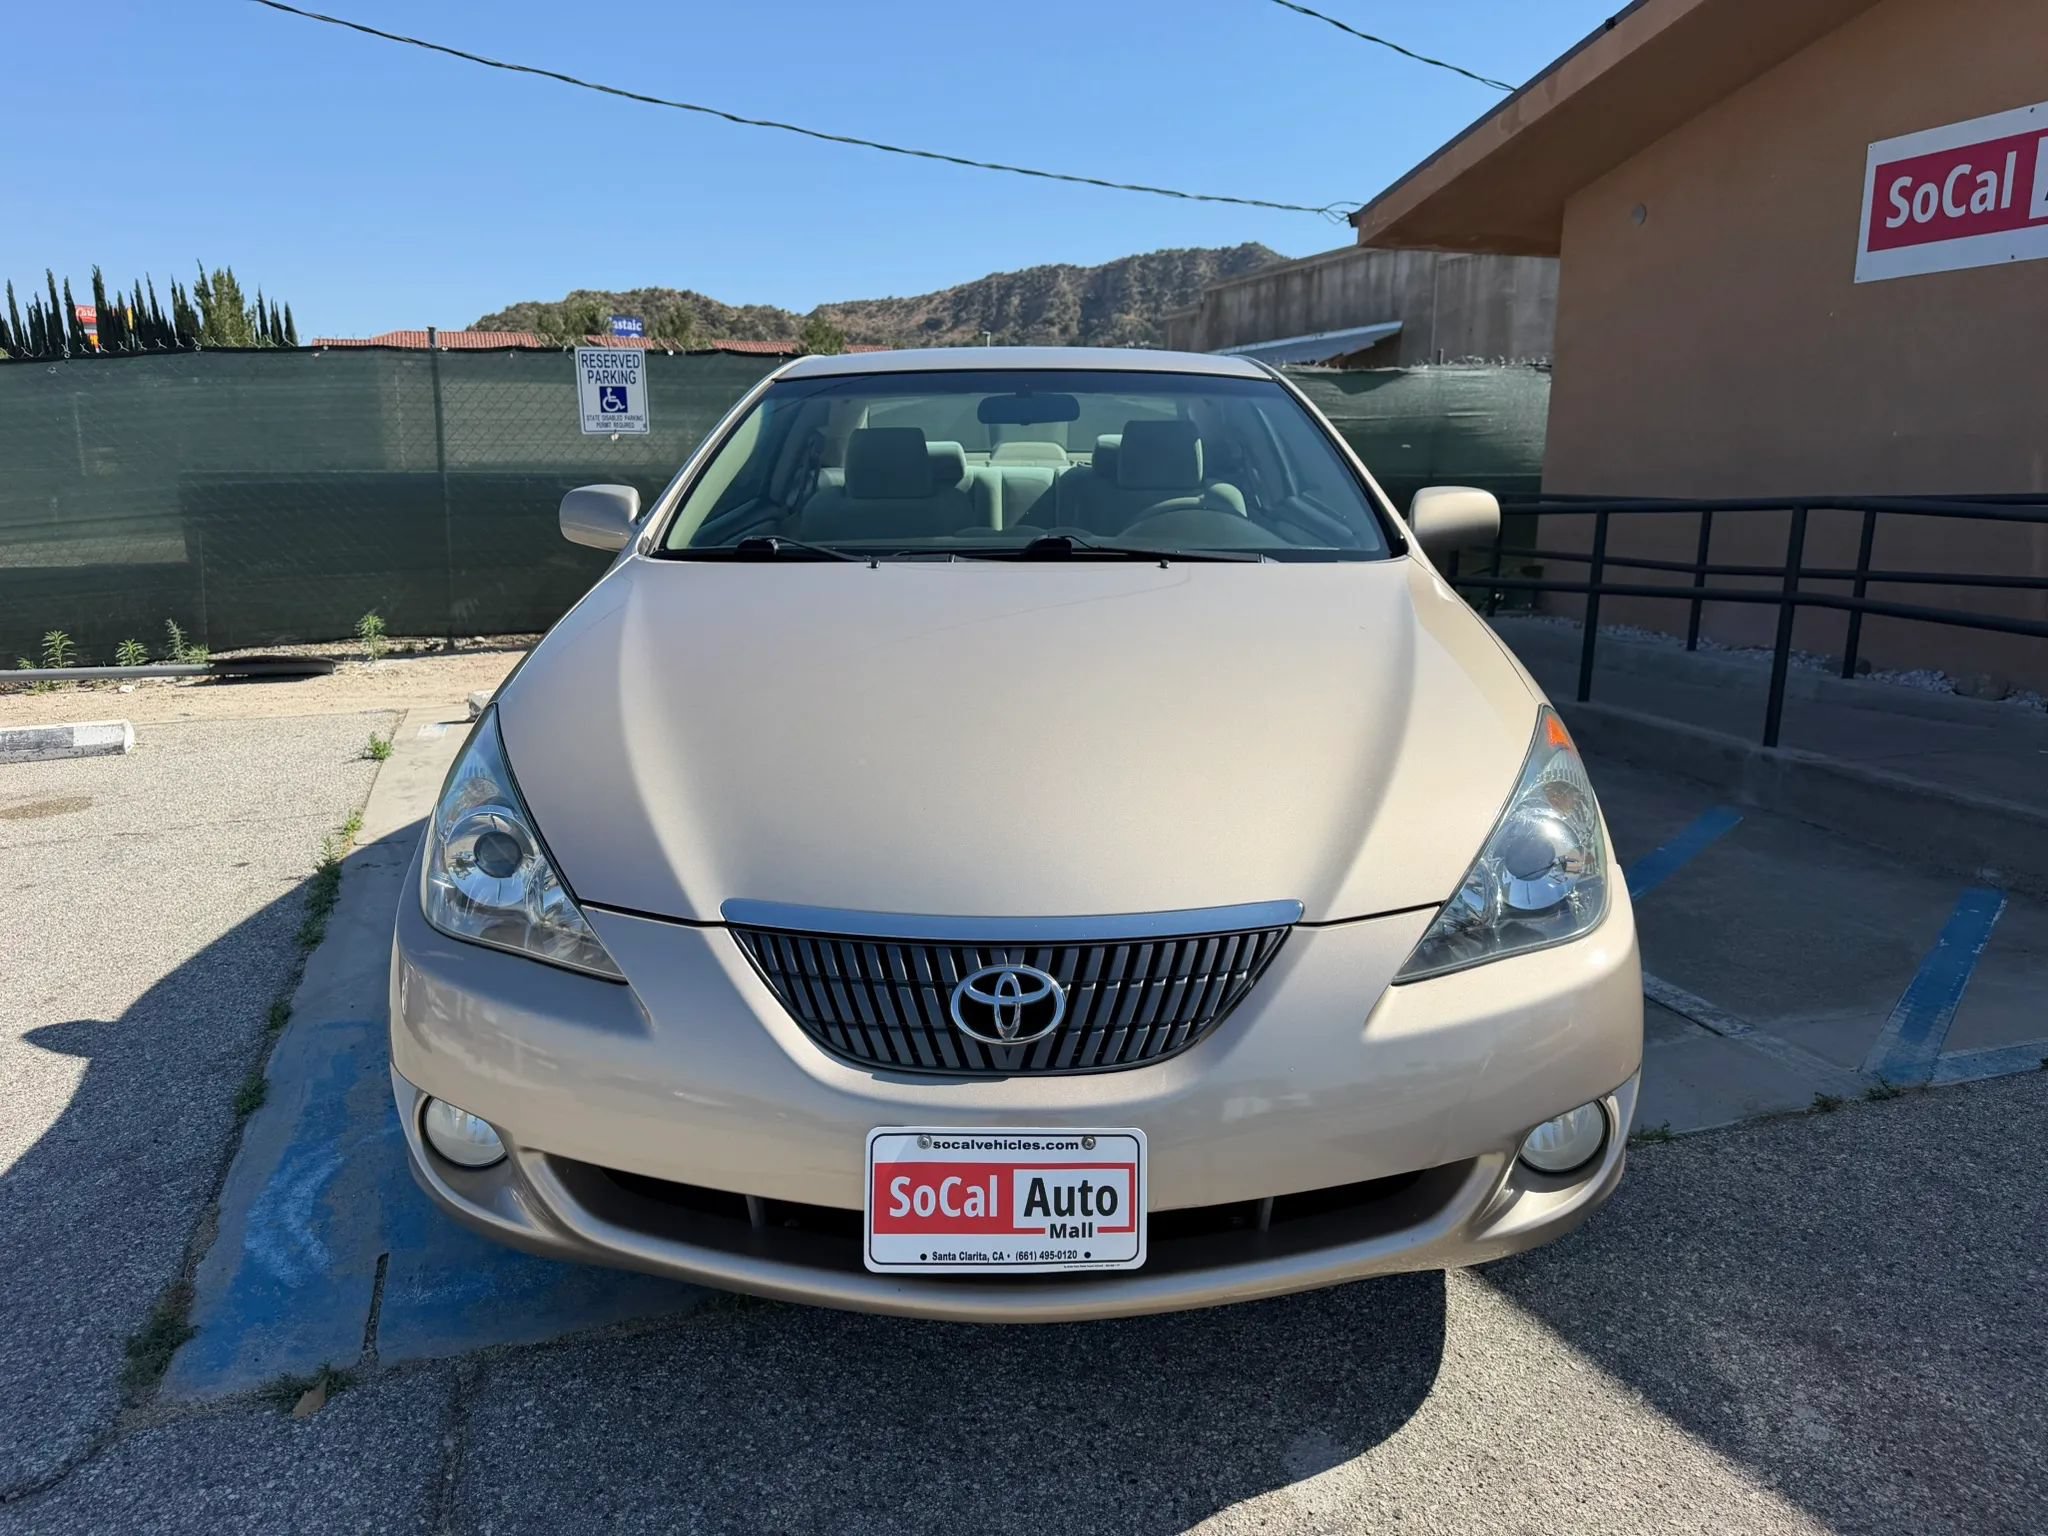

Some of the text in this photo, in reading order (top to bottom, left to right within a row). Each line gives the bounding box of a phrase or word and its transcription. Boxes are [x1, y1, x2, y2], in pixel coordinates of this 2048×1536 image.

[1885, 150, 2017, 229] SoCal
[608, 316, 643, 332] astaic
[581, 354, 640, 368] RESERVED
[587, 370, 636, 384] PARKING
[932, 1139, 1079, 1151] socalvehicles.com
[889, 1174, 1119, 1218] SoCal Auto
[1049, 1222, 1093, 1239] Mall
[932, 1250, 1078, 1263] Santa Clarita, CA (661) 495-0120
